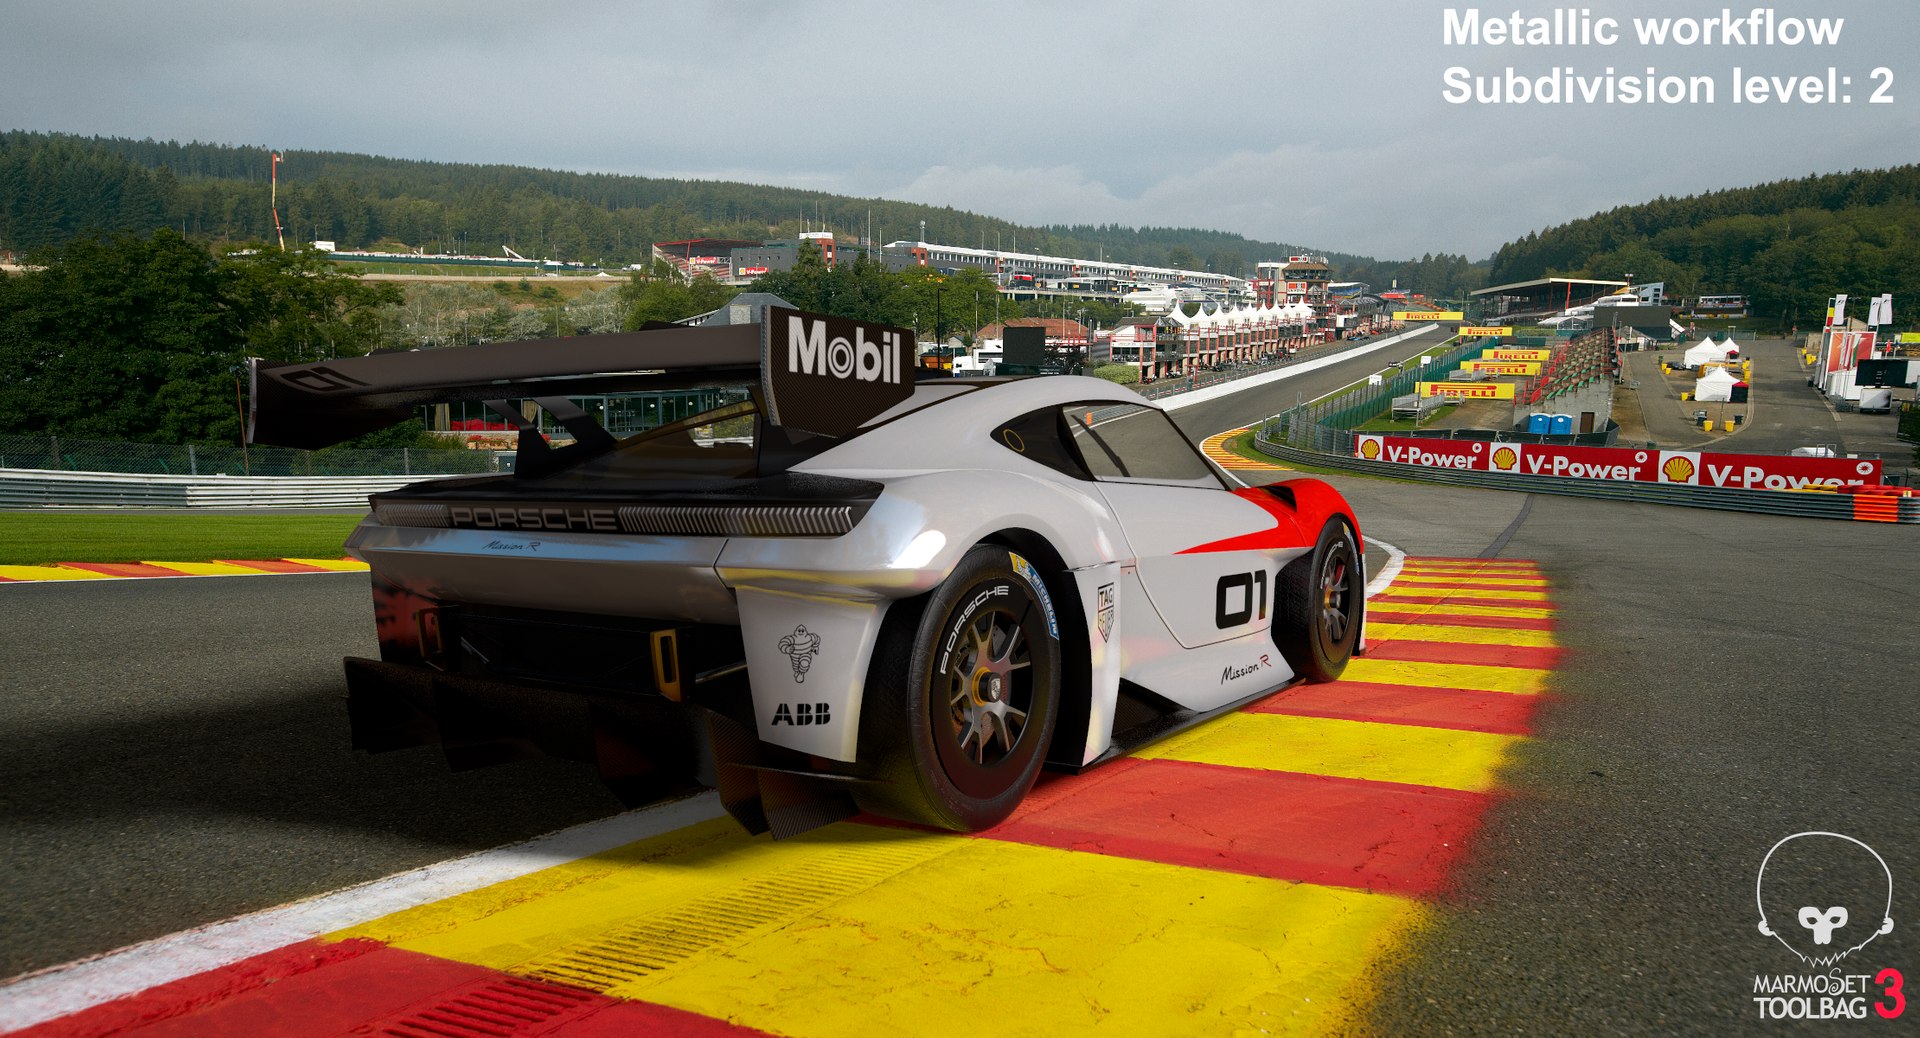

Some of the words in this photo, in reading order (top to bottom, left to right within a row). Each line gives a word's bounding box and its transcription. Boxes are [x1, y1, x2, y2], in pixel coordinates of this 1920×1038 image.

[787, 315, 901, 384] Mobil
[1493, 350, 1539, 359] PIRELLI
[280, 366, 373, 392] 01
[1473, 363, 1527, 374] PRELLI
[1387, 445, 1477, 469] V-Power
[1526, 454, 1641, 481] V-Power
[452, 506, 618, 530] PORSCHE
[482, 540, 523, 550] Mission
[526, 541, 542, 552] R
[1099, 588, 1113, 608] TAG
[1215, 569, 1267, 630] 01
[939, 585, 1009, 675] PORSCHE
[1220, 664, 1260, 685] Mission
[1259, 654, 1273, 668] R
[771, 702, 831, 726] ABB
